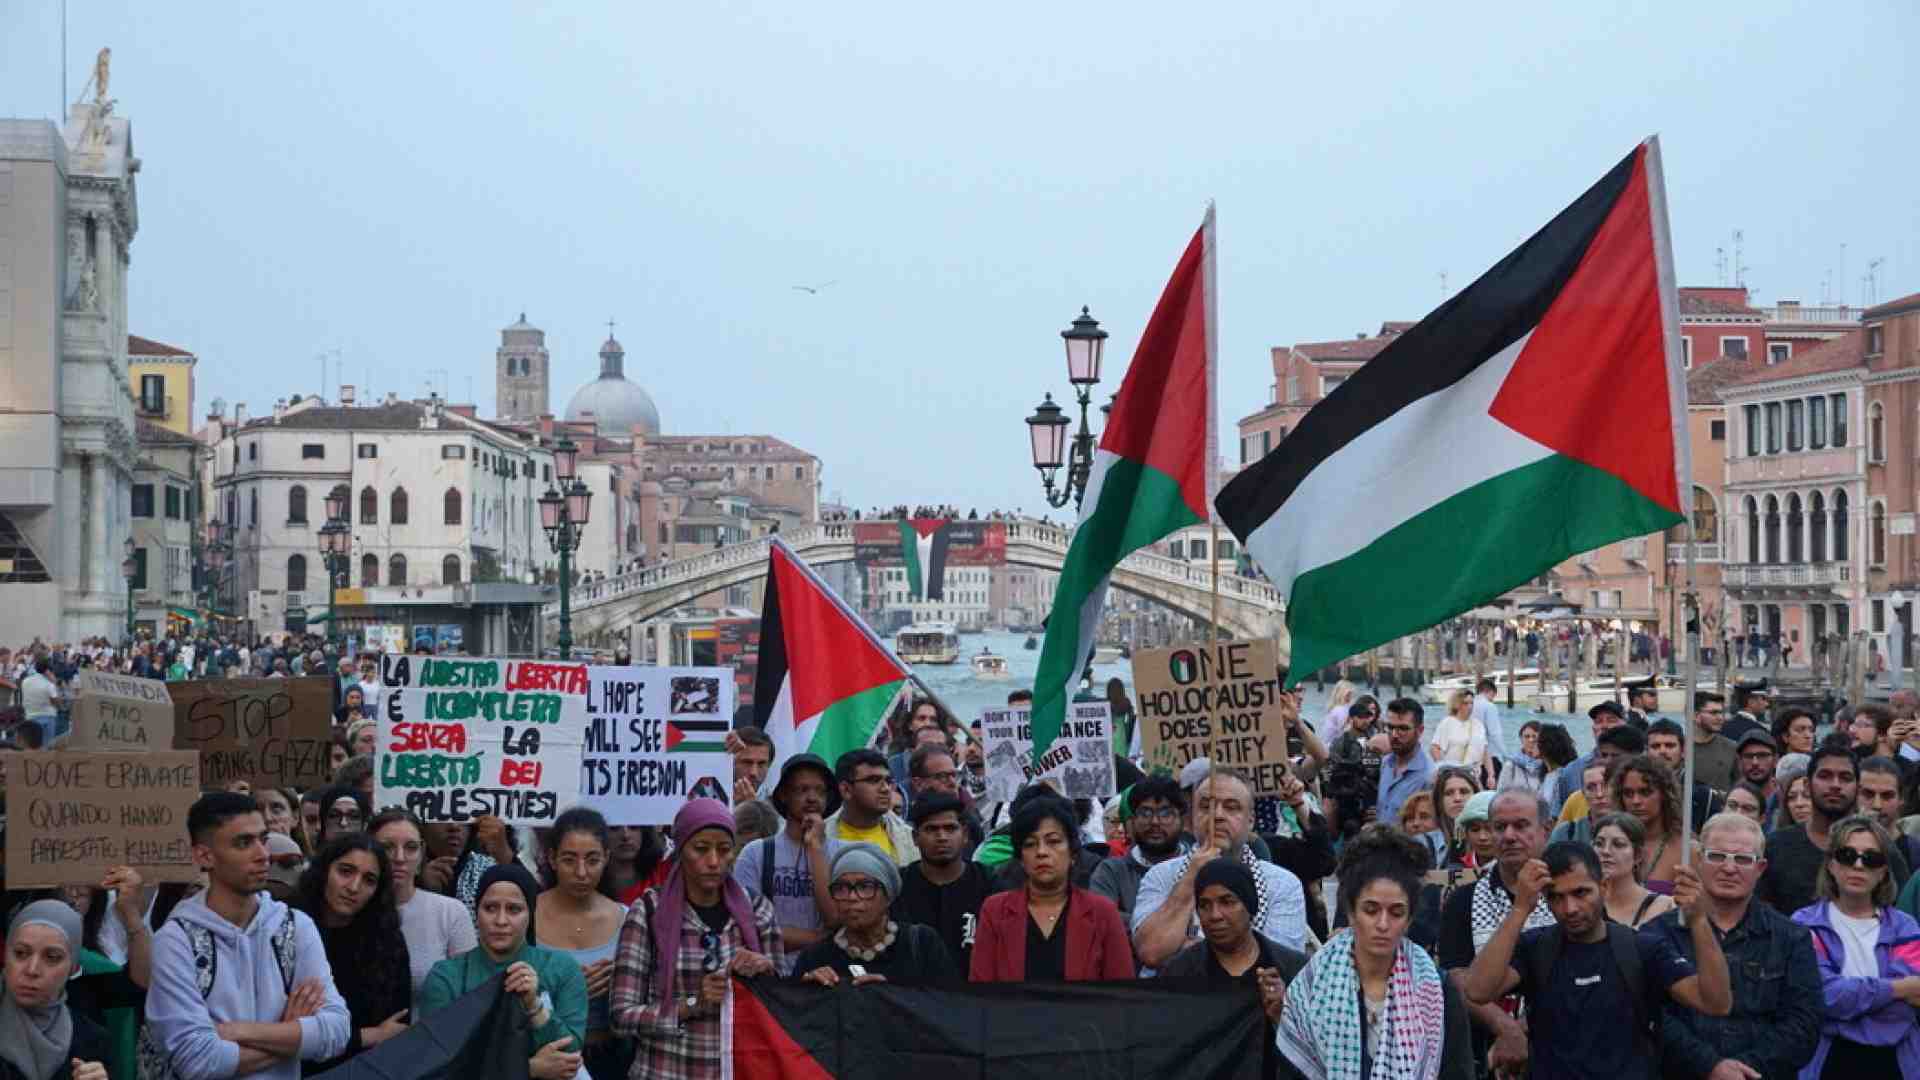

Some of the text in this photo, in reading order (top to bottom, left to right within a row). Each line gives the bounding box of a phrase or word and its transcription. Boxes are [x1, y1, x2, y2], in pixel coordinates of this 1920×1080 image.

[383, 656, 410, 687] LA
[419, 658, 499, 688] NOSTRA
[1170, 643, 1254, 685] ONE
[603, 680, 644, 713] HOPE
[1139, 680, 1276, 717] HOLOCAUST
[98, 722, 146, 744] ALLA
[185, 693, 294, 741] STOP
[1159, 712, 1262, 741] DOES NOT
[503, 726, 541, 755] LA
[629, 718, 662, 752] SEE
[23, 759, 193, 789] DOVE ERAVATE
[500, 759, 543, 787] DEI
[584, 759, 612, 795] TS
[29, 799, 174, 829] QUANDO HANNO
[406, 788, 556, 821] PALESTINESI
